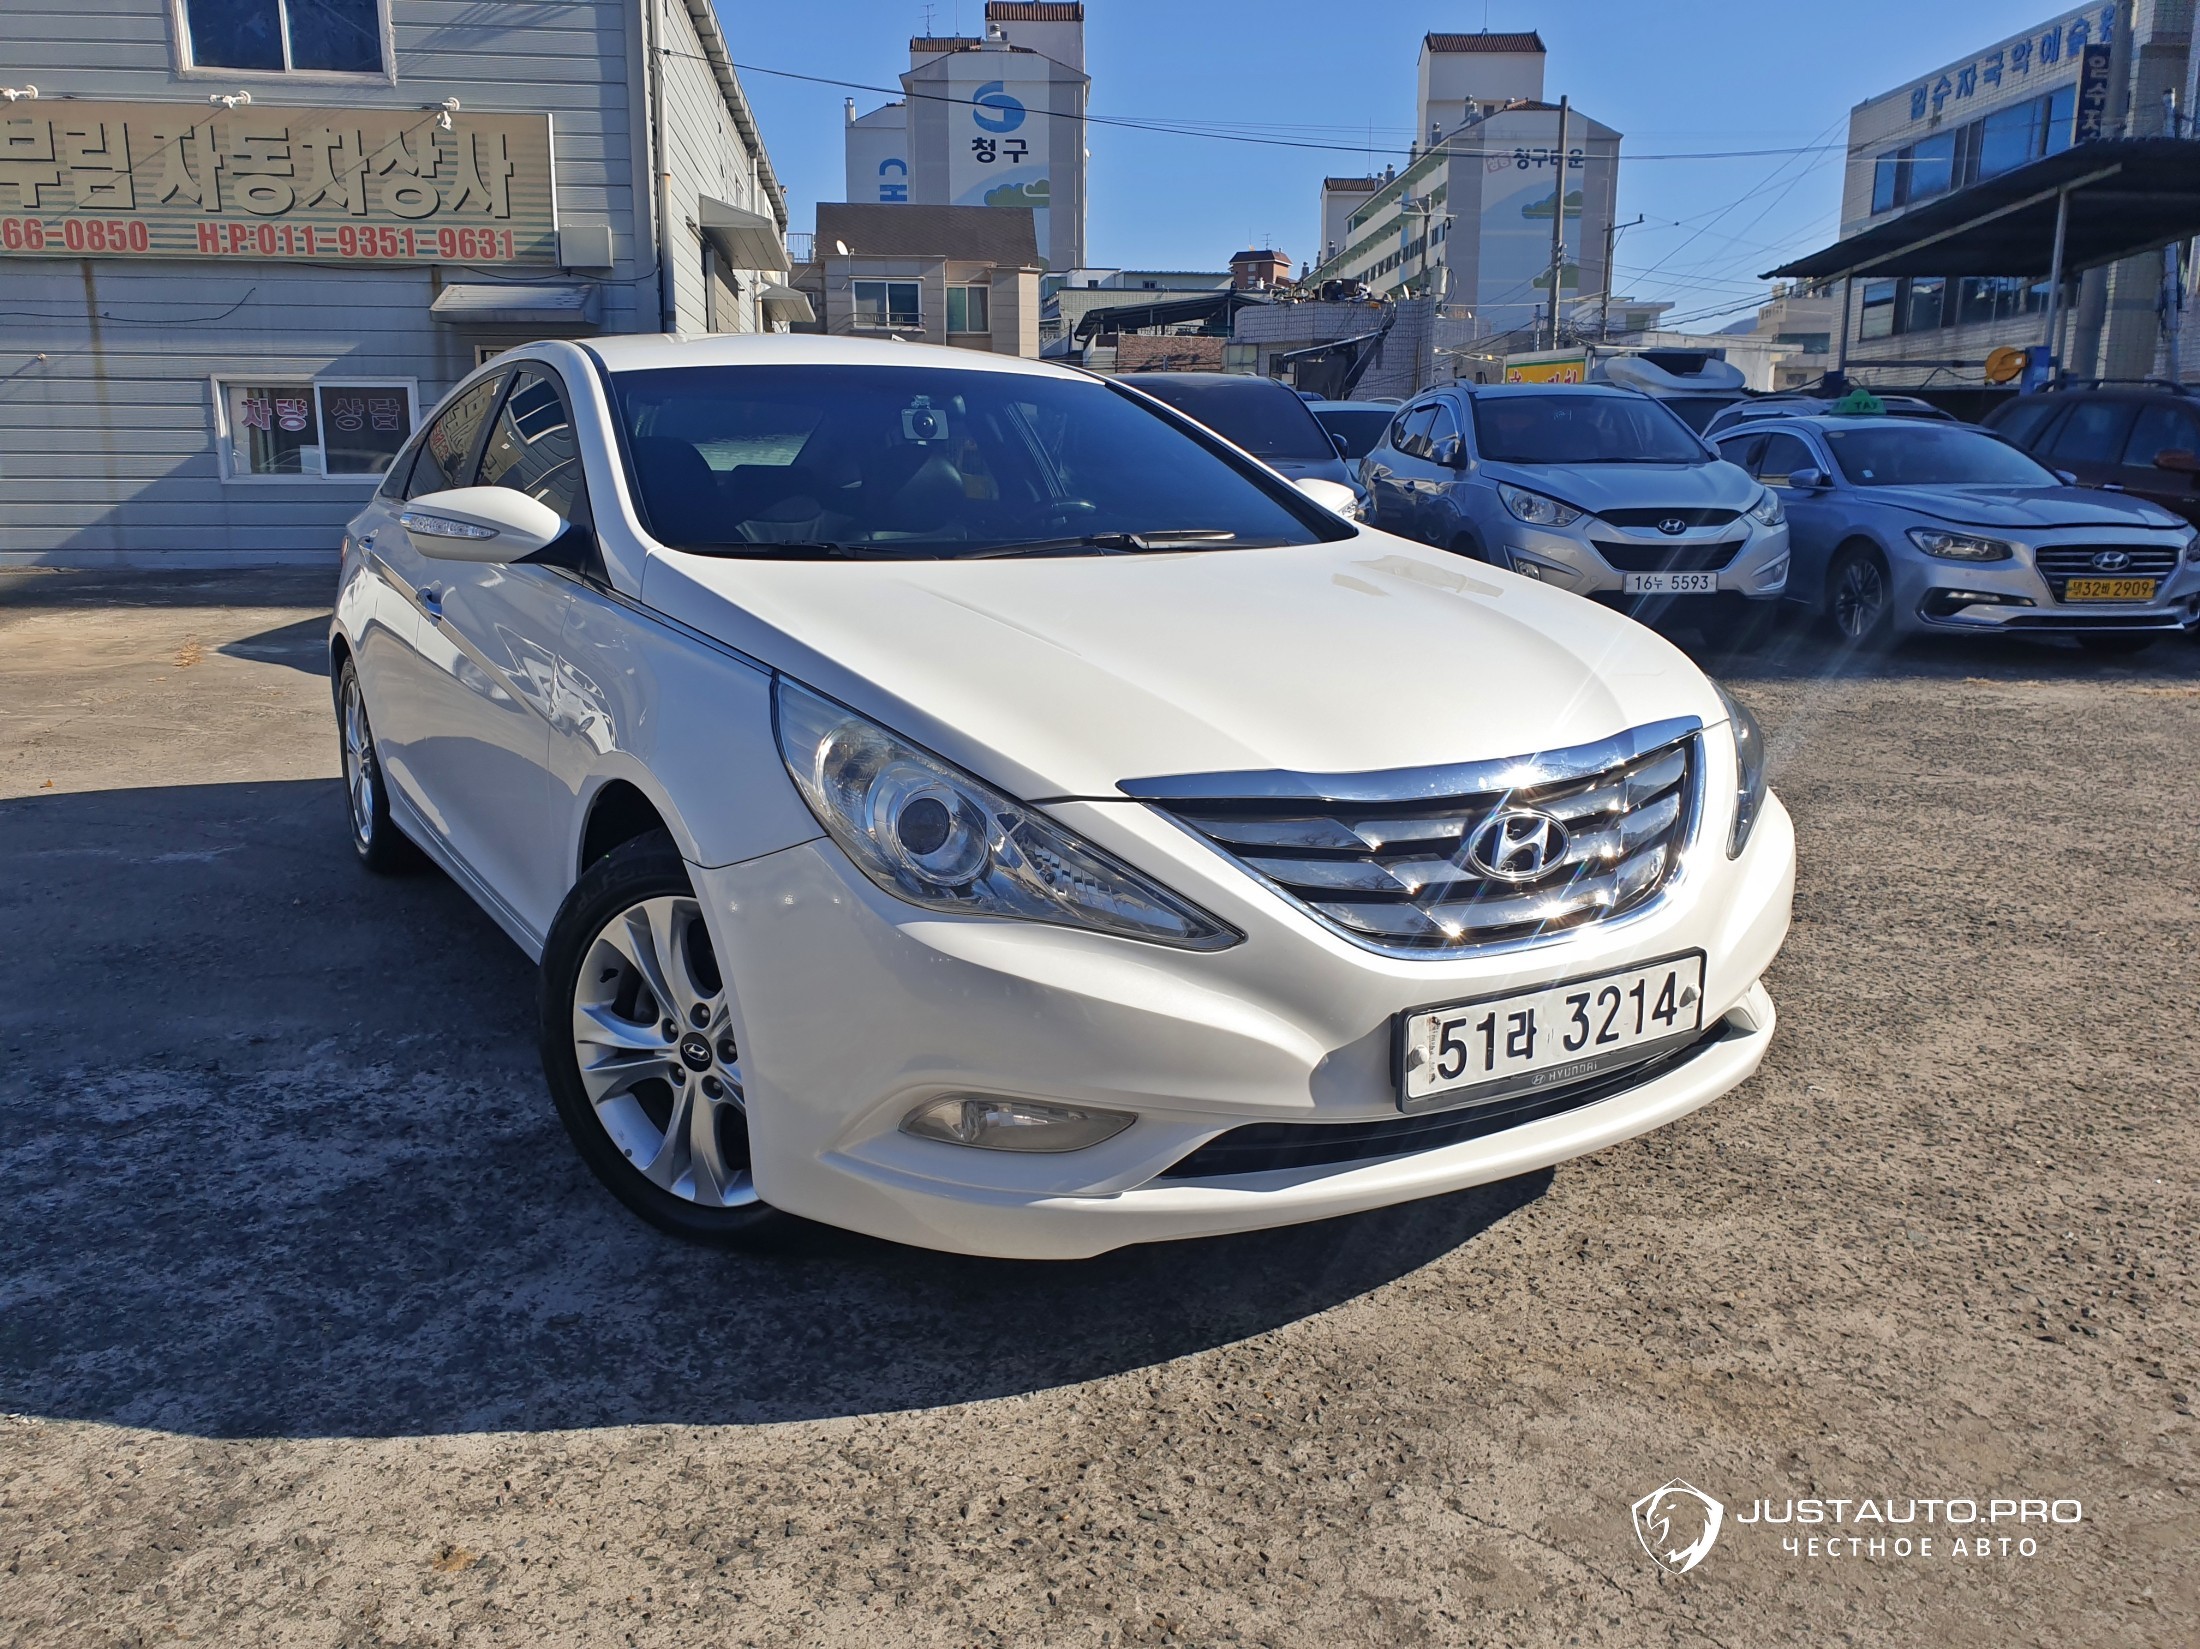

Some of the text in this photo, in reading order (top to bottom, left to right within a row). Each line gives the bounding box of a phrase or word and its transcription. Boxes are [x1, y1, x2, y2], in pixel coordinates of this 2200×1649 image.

[971, 137, 1029, 163] 청구
[2, 218, 148, 251] 66-0850
[241, 398, 400, 431] 차량 상담
[1635, 575, 1709, 590] 16누 5593
[2113, 581, 2150, 597] 2909
[1437, 971, 1678, 1080] 51라 3214
